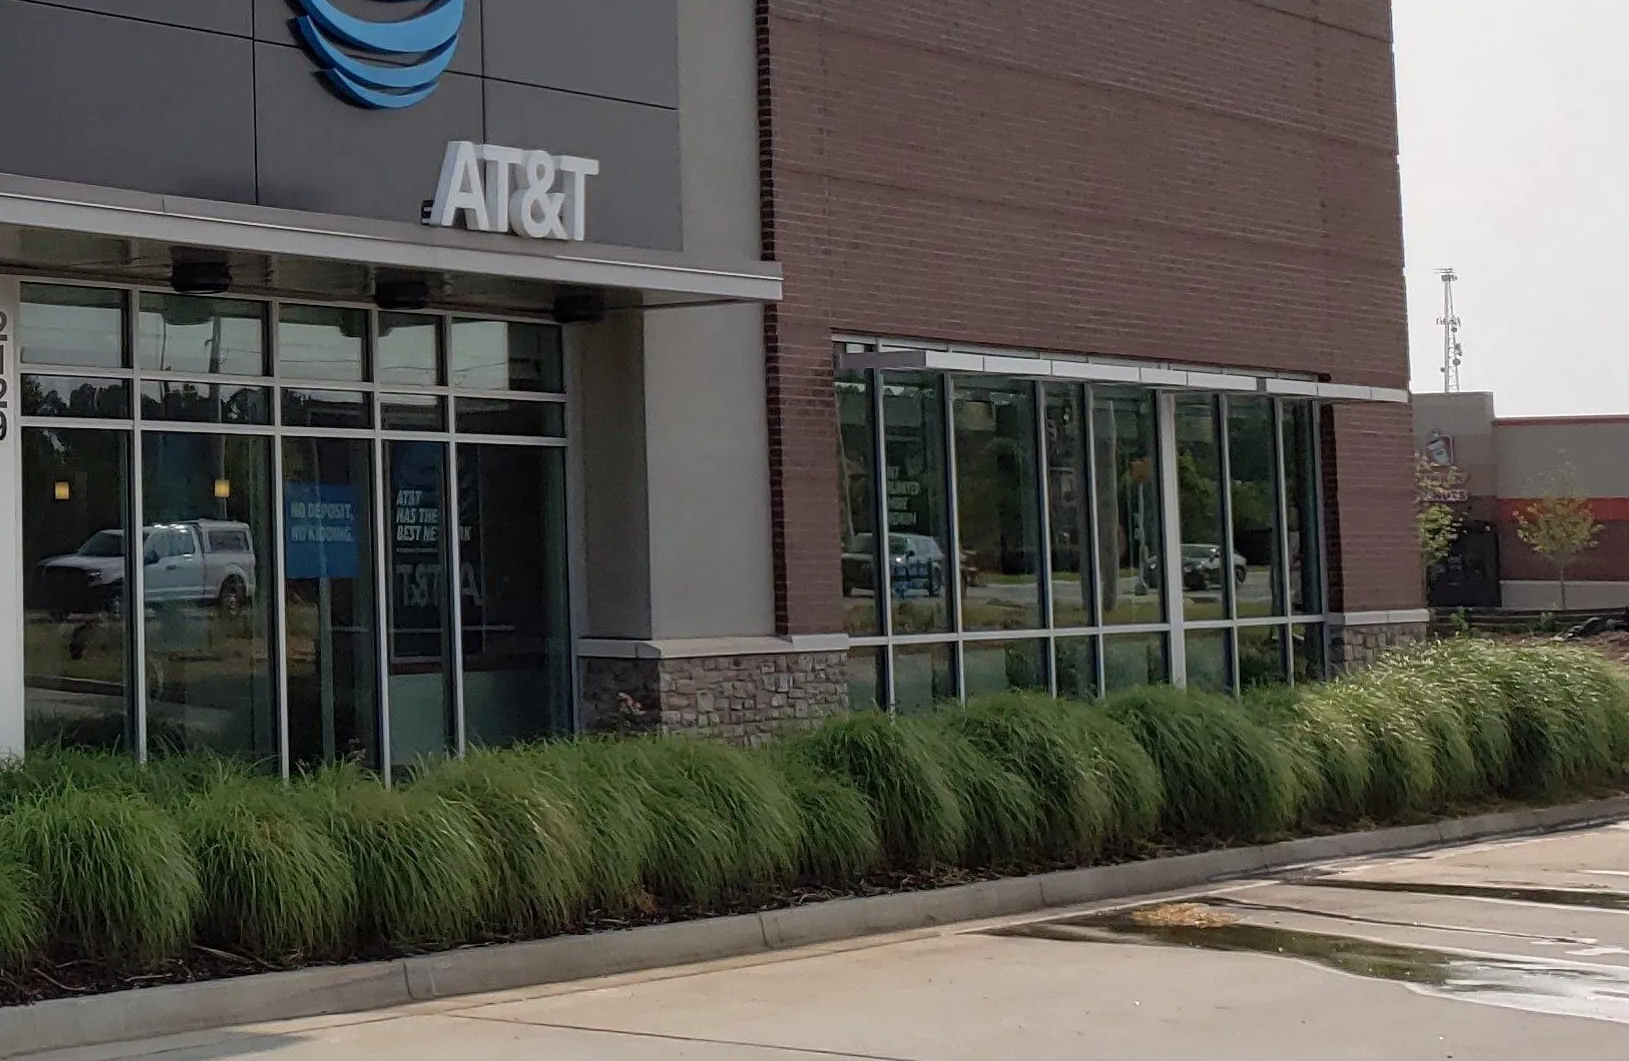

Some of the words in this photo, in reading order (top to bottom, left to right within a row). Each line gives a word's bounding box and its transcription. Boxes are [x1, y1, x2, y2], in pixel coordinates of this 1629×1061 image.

[429, 140, 600, 242] AT&T
[291, 503, 306, 518] NO
[396, 508, 417, 524] HAS
[419, 508, 439, 523] THE
[292, 527, 306, 541] NO
[397, 526, 421, 541] BEST
